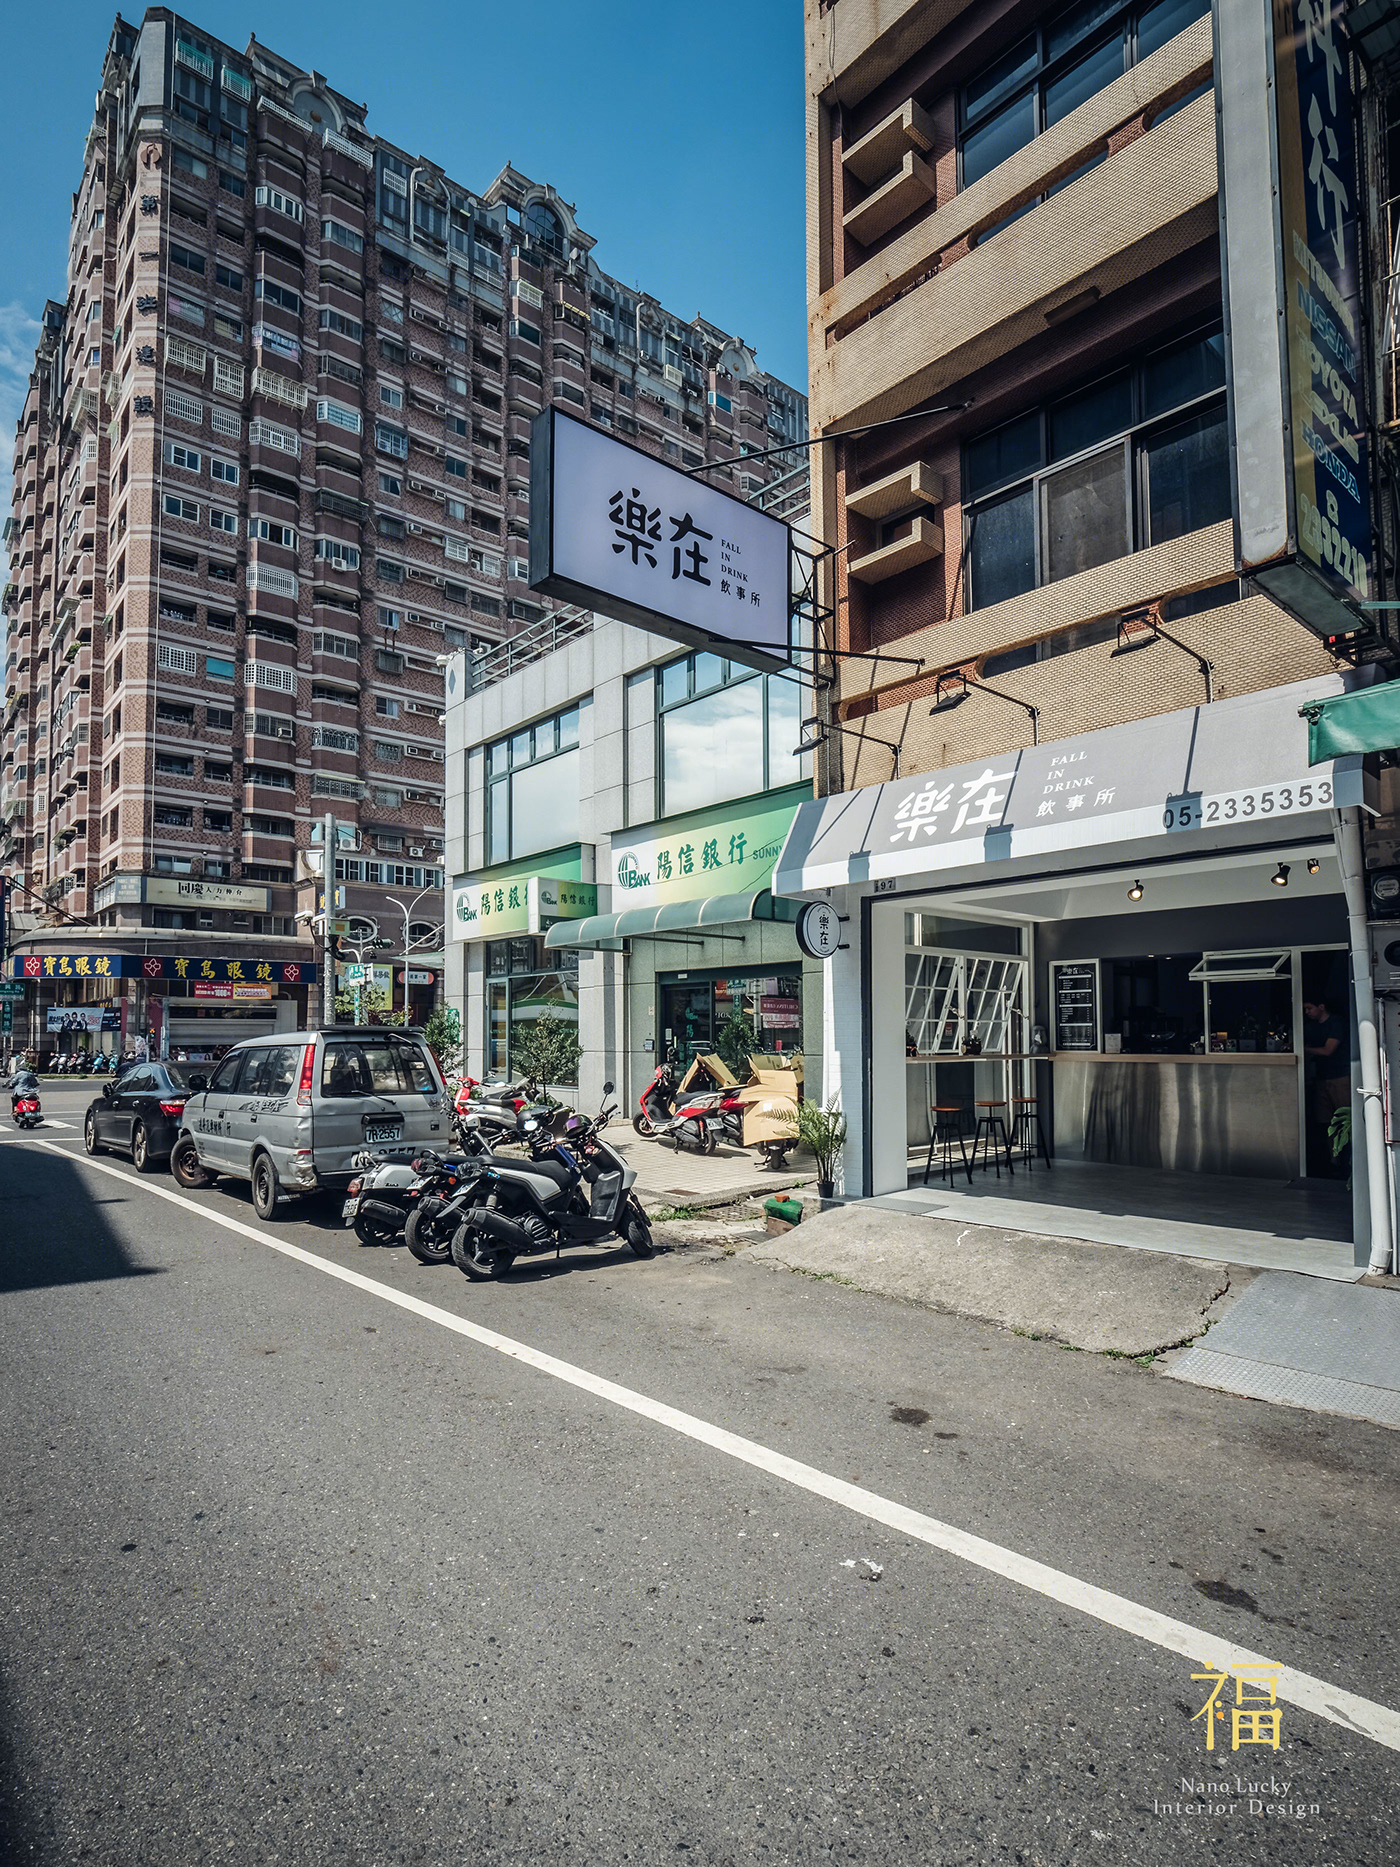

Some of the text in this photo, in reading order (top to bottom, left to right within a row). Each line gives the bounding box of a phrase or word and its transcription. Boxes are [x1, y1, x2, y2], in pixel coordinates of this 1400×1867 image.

[1297, 278, 1357, 383] NISSAN
[1296, 324, 1359, 429] TOYOTA
[1301, 417, 1361, 504] HONDA
[608, 487, 714, 587] 樂在
[721, 538, 742, 555] FALL
[721, 551, 731, 562] IN
[721, 563, 749, 583] DRINK
[720, 578, 761, 608] 飲事所
[1050, 750, 1088, 767] FALL
[1042, 775, 1095, 795] DRINK
[1046, 768, 1065, 781] IN
[889, 768, 1019, 843] 樂在
[1035, 786, 1117, 818] 飲事所
[1162, 781, 1333, 829] 05-2335353
[655, 831, 748, 880] 陽信銀行
[880, 880, 893, 891] 97
[480, 883, 528, 916] 陽信銀
[560, 893, 596, 907] 陽信銀行
[43, 955, 112, 977] 寶島眼鏡
[174, 957, 273, 981] 寶島眼鏡
